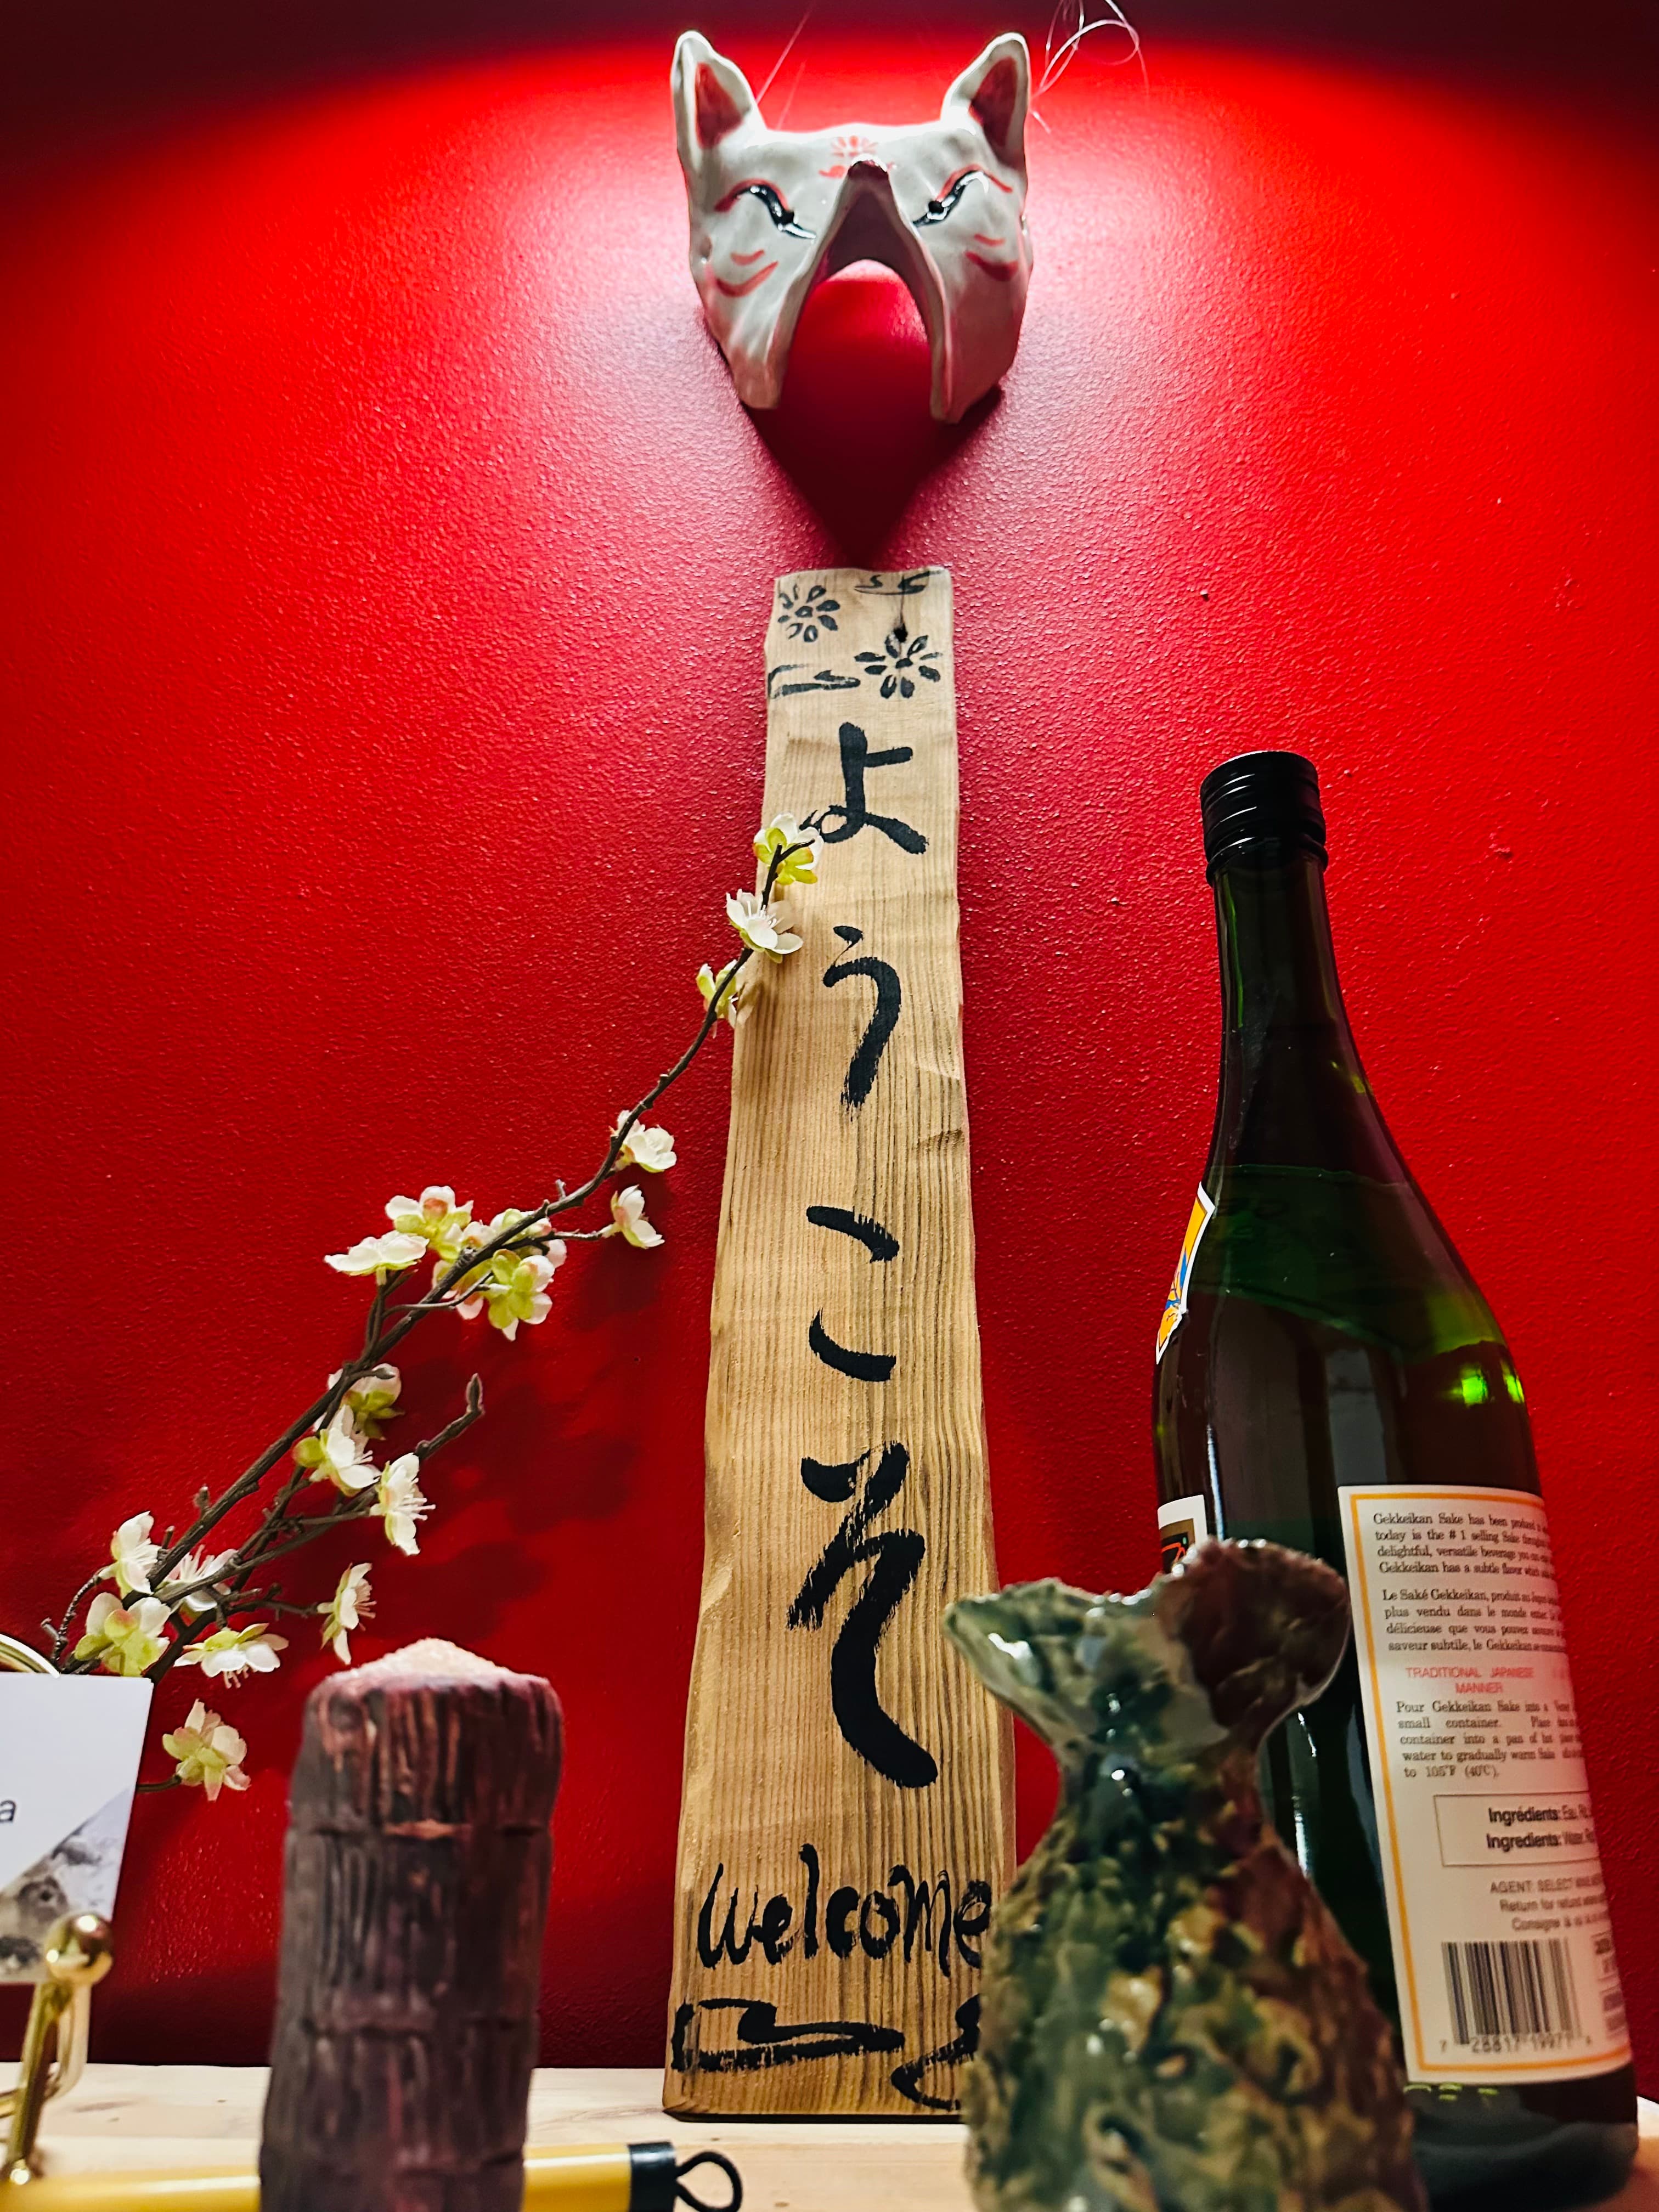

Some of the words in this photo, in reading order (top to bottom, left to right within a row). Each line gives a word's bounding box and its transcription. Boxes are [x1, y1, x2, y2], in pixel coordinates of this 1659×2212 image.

[787, 721, 938, 1788] ようこそ
[1373, 1513, 1432, 1525] Gekkeikan
[1438, 1513, 1463, 1524] Sake
[1469, 1514, 1485, 1525] has
[1489, 1514, 1508, 1526] been
[1375, 1529, 1406, 1543] today
[1412, 1529, 1421, 1540] is
[1427, 1529, 1444, 1540] the
[1461, 1530, 1466, 1540] 1
[1471, 1530, 1499, 1544] selling
[1378, 1544, 1432, 1558] delightful,
[1436, 1545, 1477, 1556] versatile
[1379, 1561, 1438, 1573] Gekkeikan
[1442, 1561, 1460, 1572] has
[1474, 1562, 1499, 1573] subtle
[1383, 1589, 1398, 1600] Le
[1400, 1589, 1428, 1600] Saké
[1430, 1589, 1489, 1601] Gekkeikan,
[1385, 1606, 1409, 1619] plus
[1417, 1605, 1450, 1616] vendu
[1458, 1605, 1481, 1616] dans
[1487, 1606, 1496, 1616] le
[1386, 1622, 1442, 1633] délicieuse
[1448, 1625, 1468, 1635] que
[1389, 1642, 1427, 1651] saveur
[1431, 1639, 1471, 1651] subtile,
[1473, 1639, 1482, 1650] le
[1406, 1666, 1482, 1678] TRADITIONAL
[1455, 1682, 1503, 1694] MANNER
[1396, 1700, 1424, 1712] Pour
[1432, 1700, 1492, 1712] Gekkeikan
[1497, 1700, 1520, 1712] Sake
[1398, 1716, 1430, 1728] small
[1446, 1717, 1502, 1728] container.
[1400, 1733, 1455, 1744] container
[1464, 1733, 1485, 1743] into
[1493, 1735, 1499, 1743] a
[1402, 1751, 1436, 1760] water
[1441, 1751, 1453, 1760] to
[1457, 1748, 1506, 1763] gradually
[1404, 1767, 1417, 1778] to
[1488, 1805, 1560, 1826] Ingrédients:
[1486, 1832, 1562, 1853] Ingredients:
[1490, 1880, 1532, 1893] AGENT
[1537, 1877, 1573, 1892] SELECT
[1499, 1898, 1538, 1912] Return
